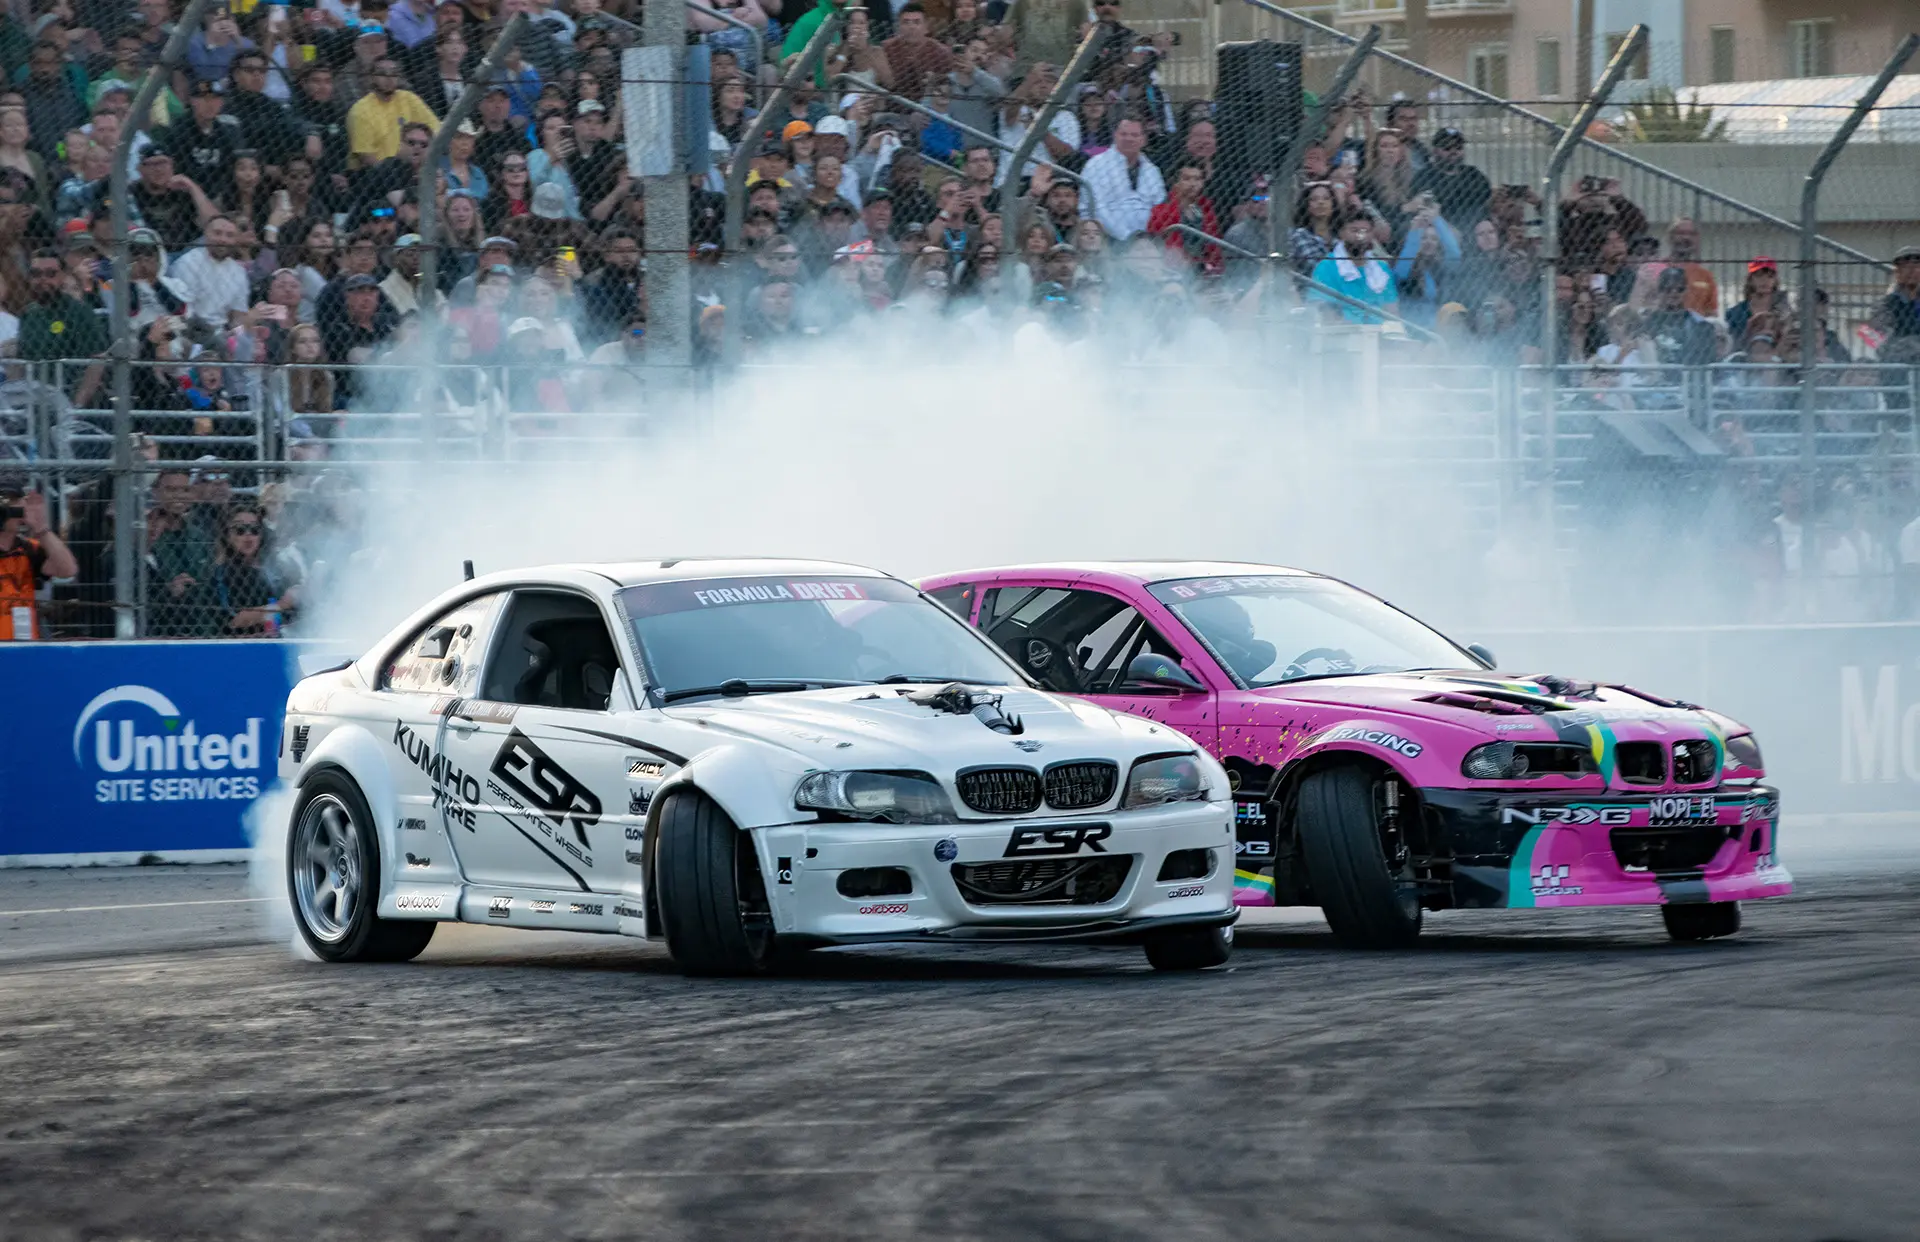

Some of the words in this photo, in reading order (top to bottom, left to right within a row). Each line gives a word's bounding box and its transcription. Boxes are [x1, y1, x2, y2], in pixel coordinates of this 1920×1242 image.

[694, 585, 793, 605] FORMULA
[791, 582, 864, 600] DRIFT
[96, 717, 262, 773] United
[393, 718, 481, 806] KUMHO
[1335, 727, 1422, 758] RACING
[96, 778, 145, 802] SITE
[149, 776, 261, 801] SERVICES
[489, 725, 603, 851] ESR
[486, 778, 553, 838] PERFORMANCE
[554, 831, 594, 868] WHEELS
[1002, 821, 1113, 858] ESR
